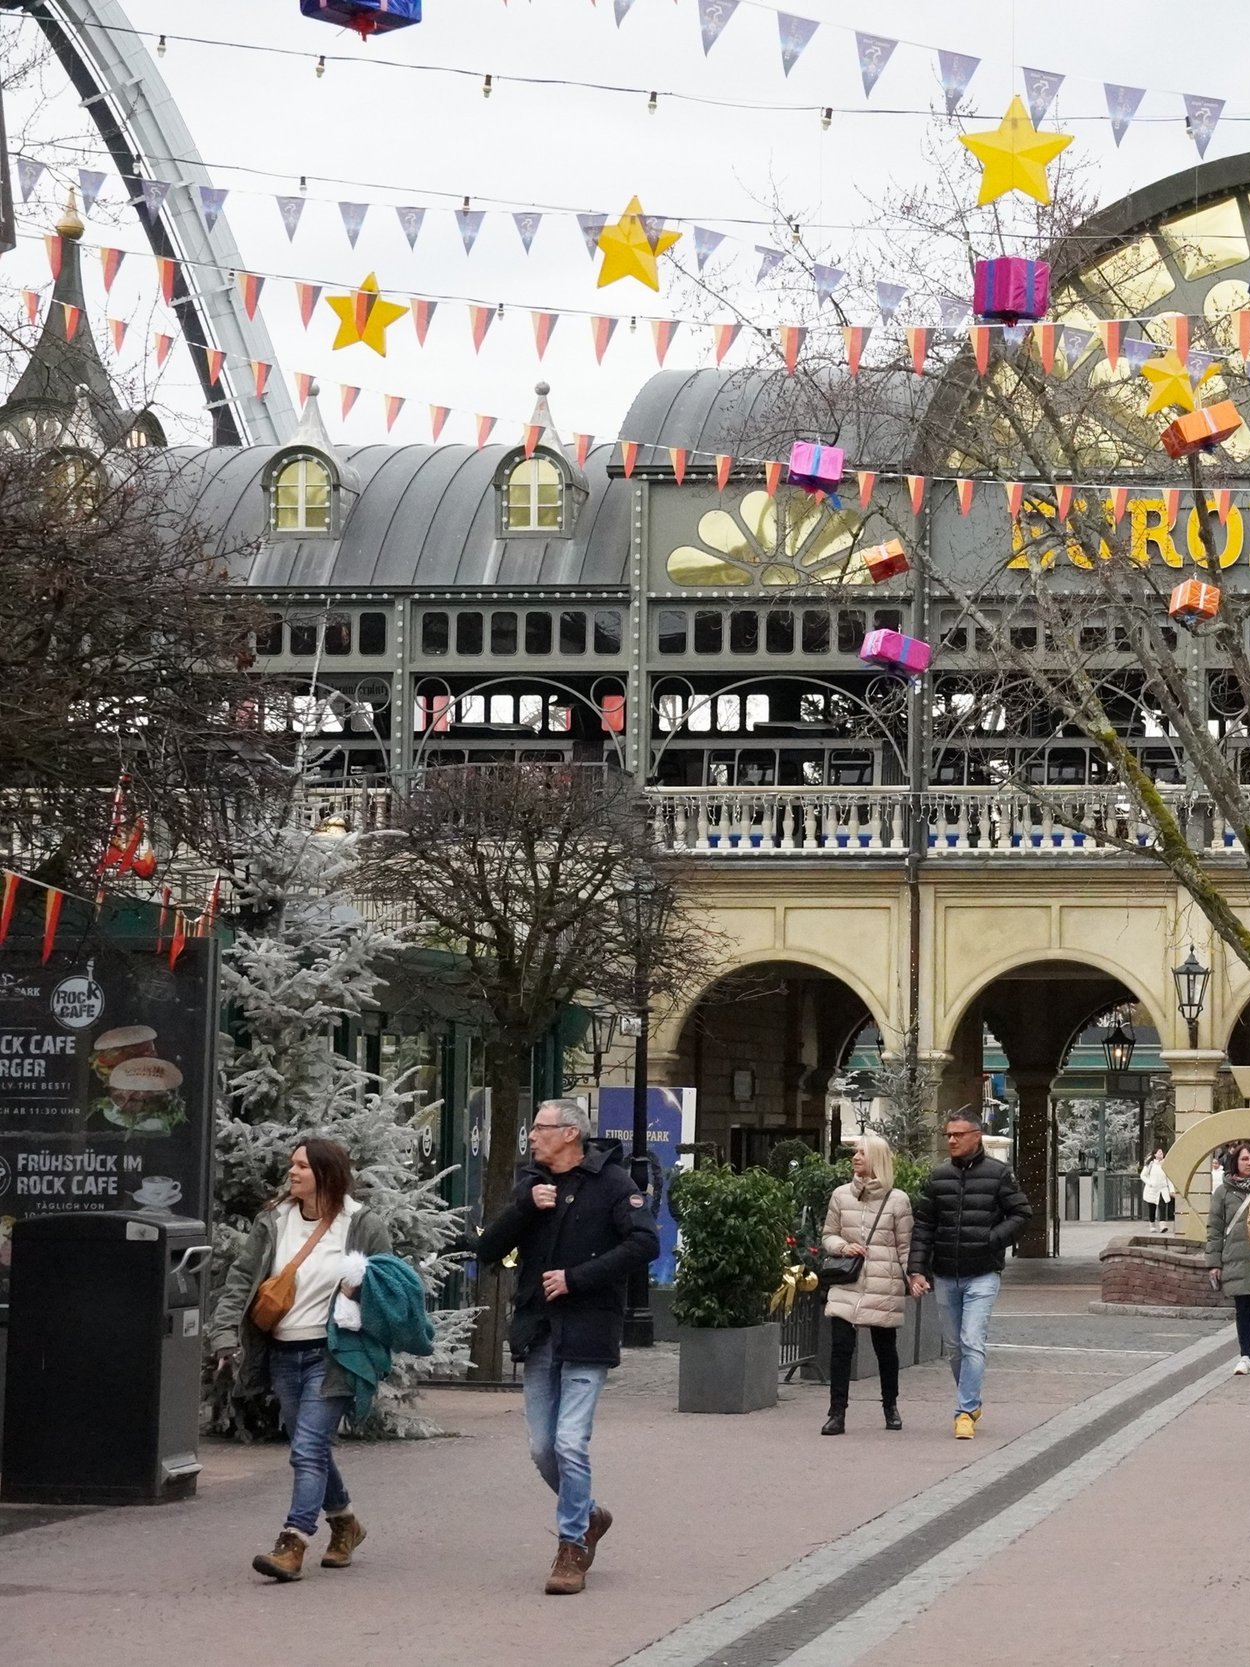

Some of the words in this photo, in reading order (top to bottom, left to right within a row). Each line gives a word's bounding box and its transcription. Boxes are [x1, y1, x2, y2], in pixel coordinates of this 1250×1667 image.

[56, 980, 100, 1005] ROCK
[60, 1004, 95, 1019] CAFE
[29, 1034, 77, 1055] CAFE
[18, 1082, 37, 1090] THE
[13, 1107, 27, 1115] AB
[60, 1107, 81, 1115] UHR
[605, 1129, 634, 1141] EUROP
[646, 1130, 670, 1142] PARK
[17, 1148, 119, 1172] FRÜHSTÜCK
[123, 1154, 143, 1173] IM
[17, 1175, 67, 1195] ROCK
[71, 1175, 118, 1196] CAFE
[36, 1201, 80, 1211] TÄGLICH
[83, 1202, 105, 1210] VON
